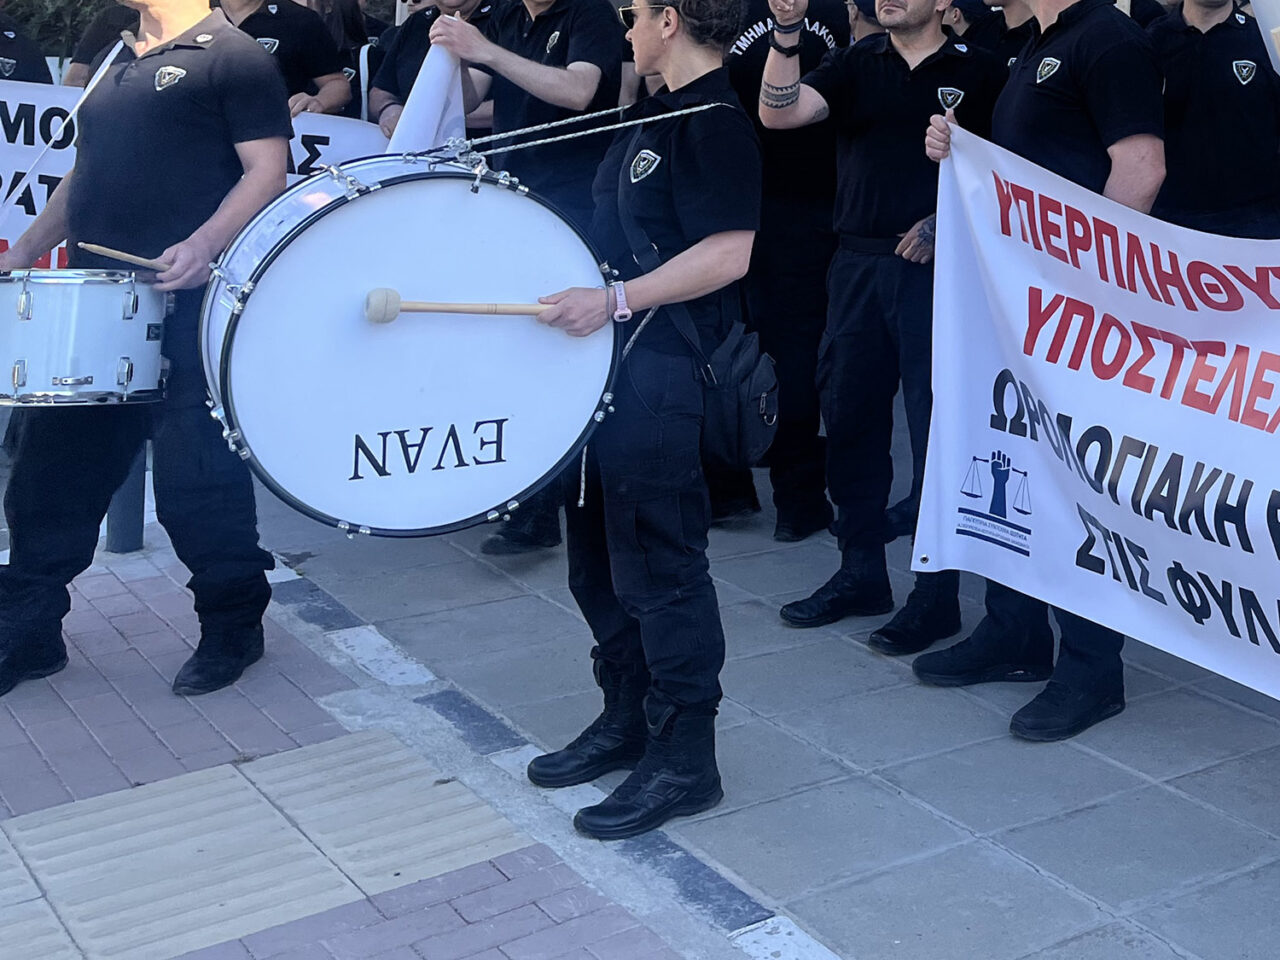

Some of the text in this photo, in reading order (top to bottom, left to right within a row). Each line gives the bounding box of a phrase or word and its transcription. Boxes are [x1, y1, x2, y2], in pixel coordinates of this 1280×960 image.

[348, 418, 509, 481] EVAN
[990, 368, 1255, 555] ΩΡΟΛΟΓΙΑΚΗ
[1075, 502, 1168, 606] ΣΤΙΣ
